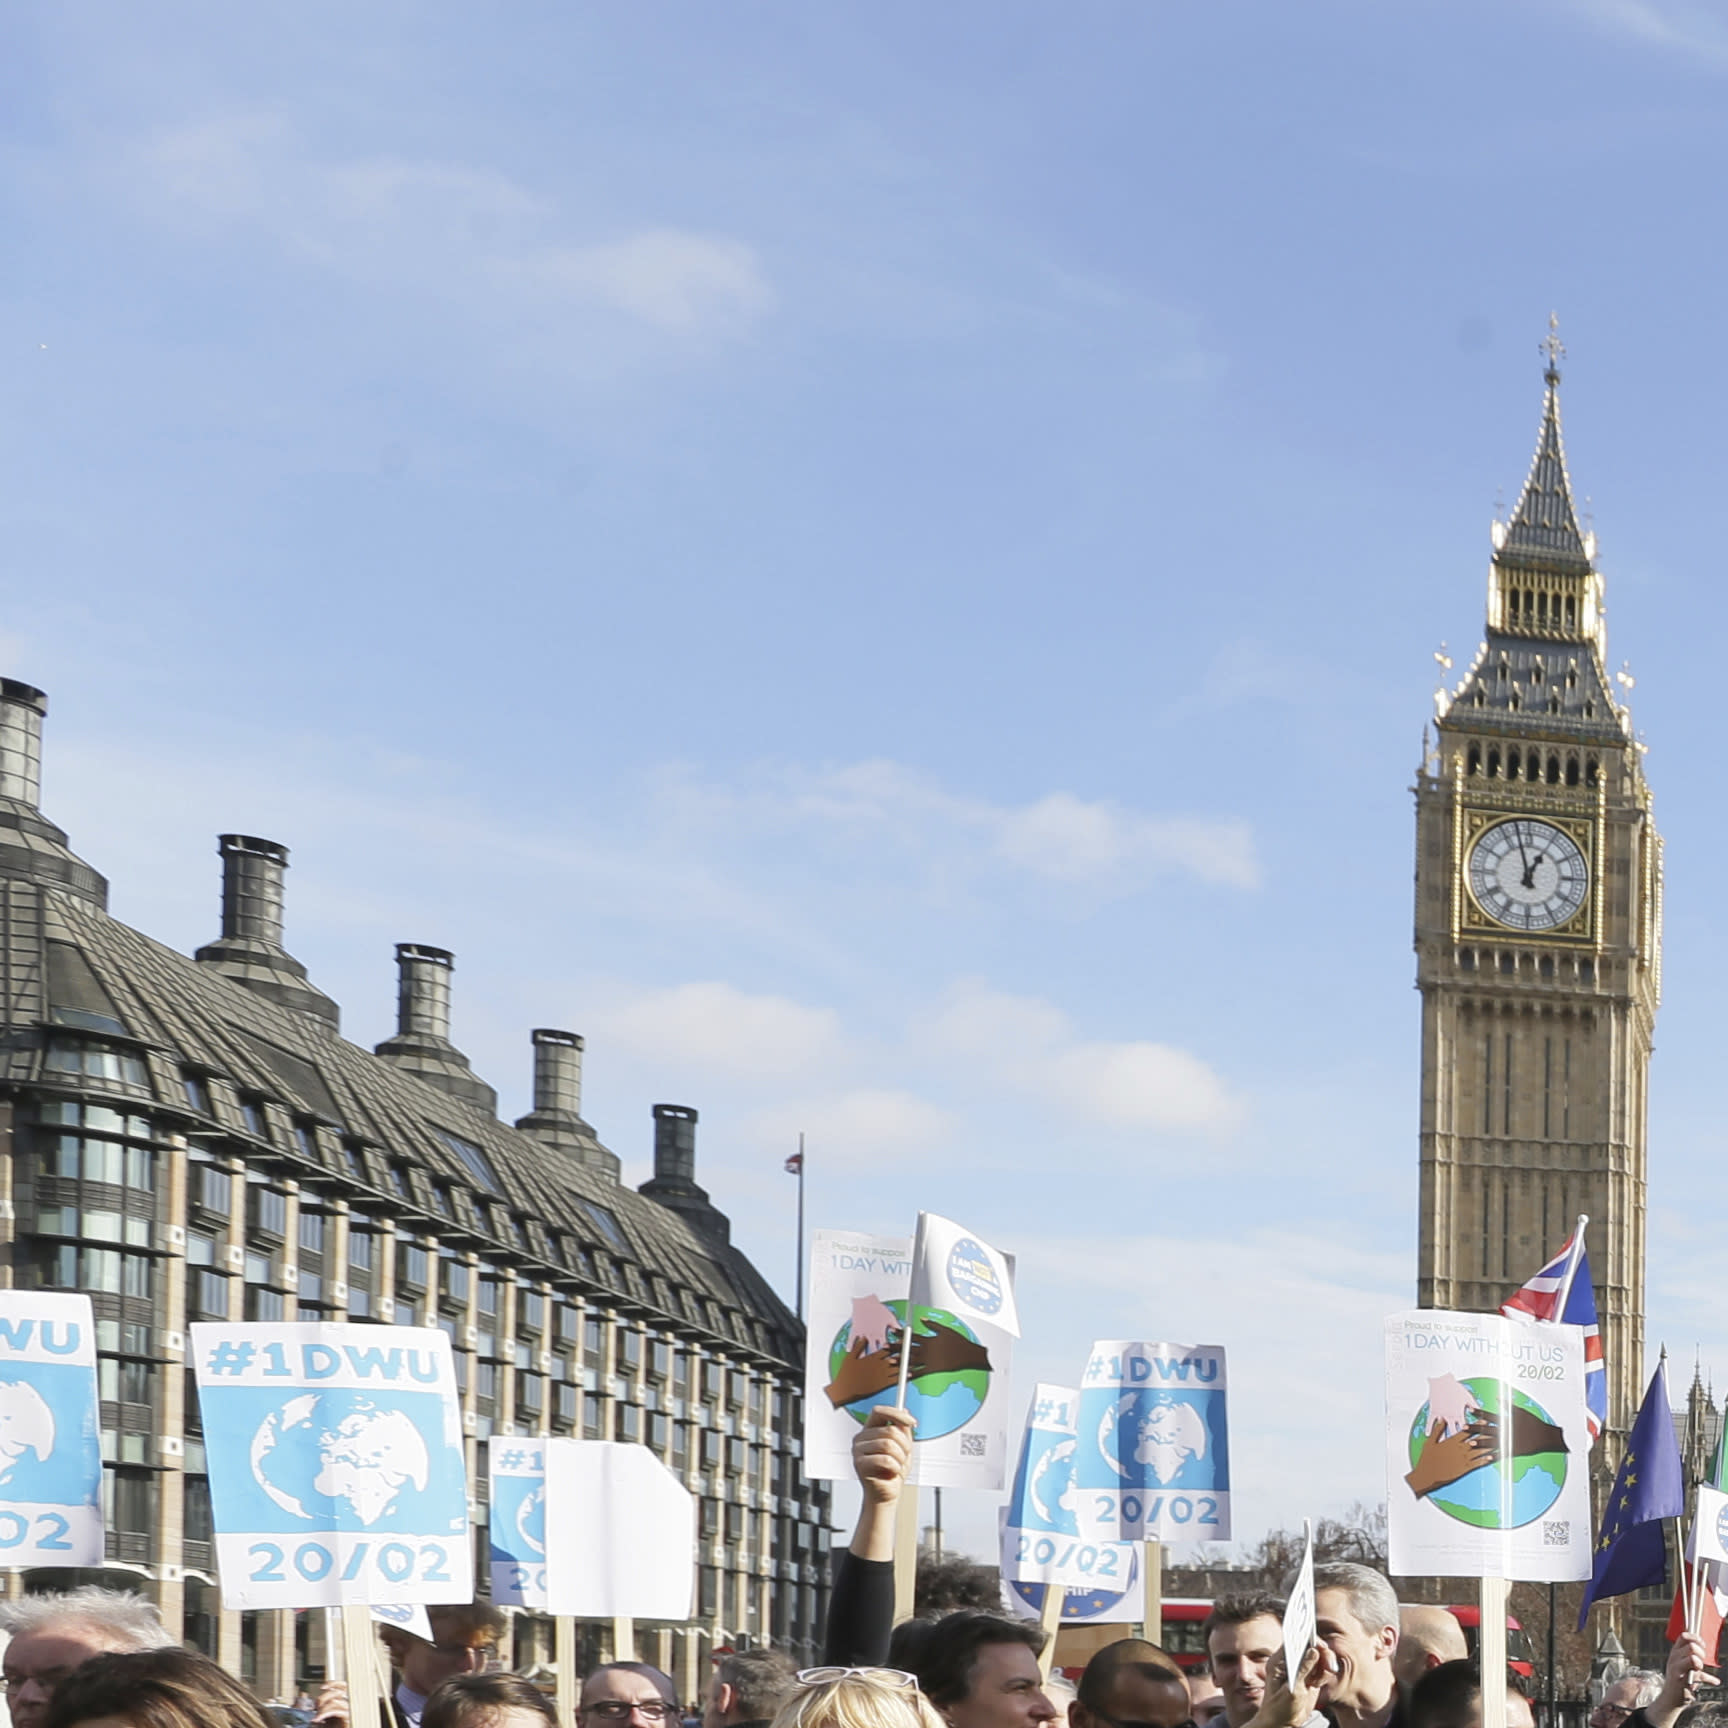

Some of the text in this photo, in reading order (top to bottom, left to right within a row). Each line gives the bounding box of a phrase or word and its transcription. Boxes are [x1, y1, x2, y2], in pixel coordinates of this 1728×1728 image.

[207, 1341, 440, 1383] #1DWU
[1405, 1334, 1564, 1362] 1DAY WITHUT US
[1086, 1356, 1218, 1382] #1DWU
[1518, 1364, 1564, 1381] 20/02
[1096, 1495, 1219, 1524] 20/02
[249, 1542, 451, 1582] 20/02
[1015, 1536, 1119, 1576] 20/02
